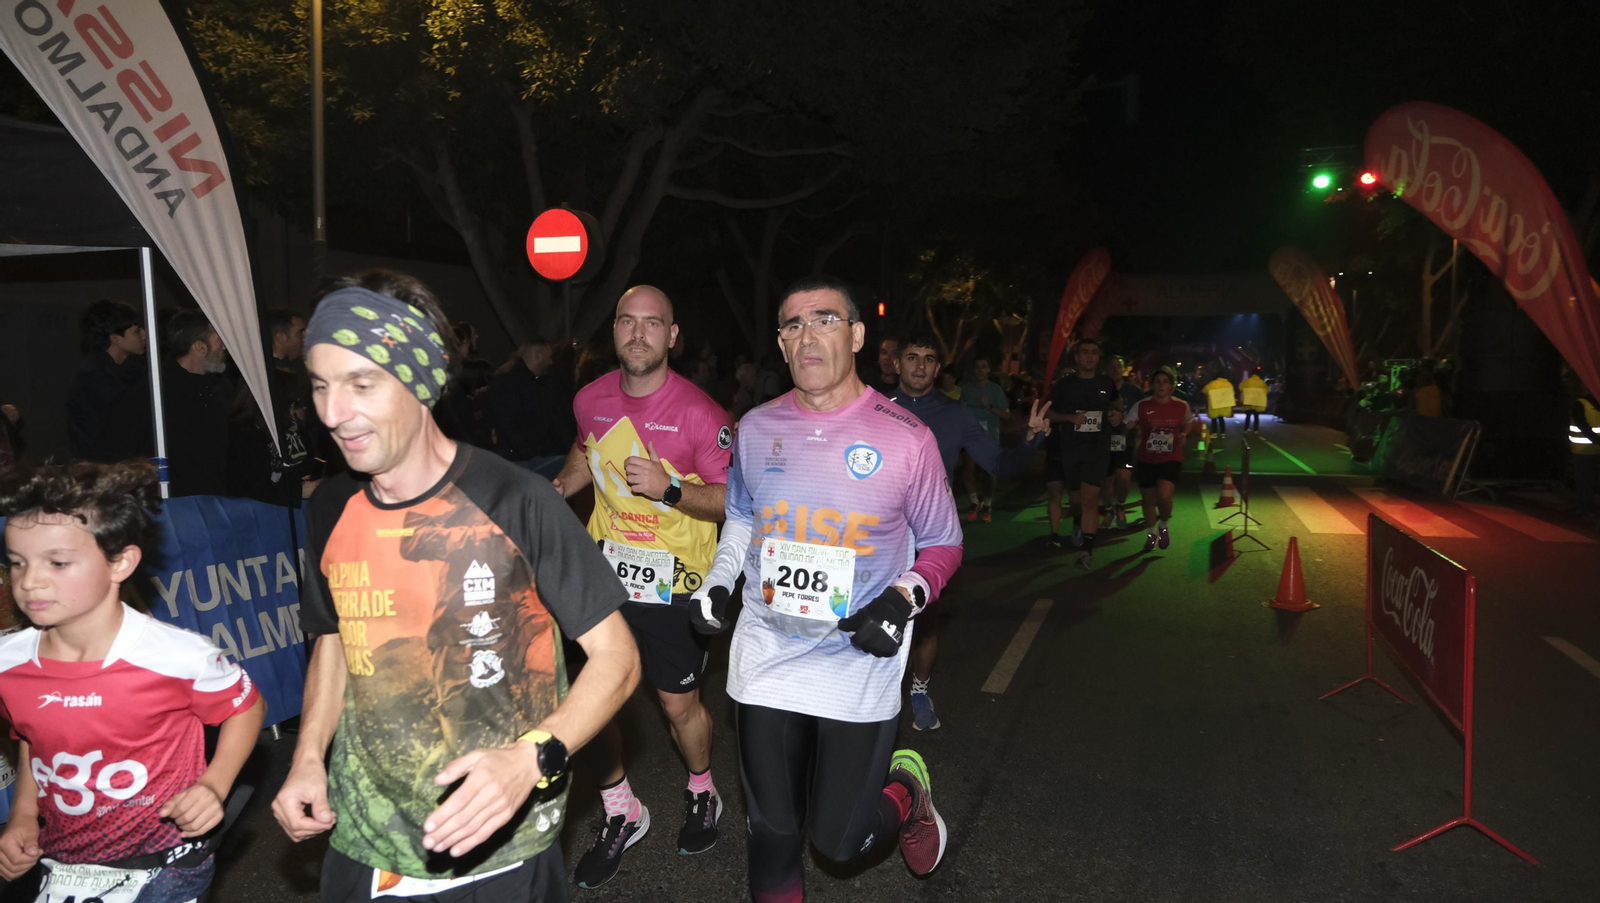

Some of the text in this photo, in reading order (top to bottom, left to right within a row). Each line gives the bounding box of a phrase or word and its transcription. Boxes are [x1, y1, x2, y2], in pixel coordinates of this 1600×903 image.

[874, 403, 918, 429] gasolia
[792, 545, 806, 554] SAN
[808, 547, 850, 559] SILVETRE
[805, 555, 815, 563] DE
[617, 561, 655, 583] 679
[776, 565, 828, 593] 208
[151, 548, 307, 618] YUNTA
[463, 579, 495, 593] CXM
[782, 591, 819, 602] PEPE TORRES
[64, 692, 102, 708] rasán
[73, 876, 89, 887] DE
